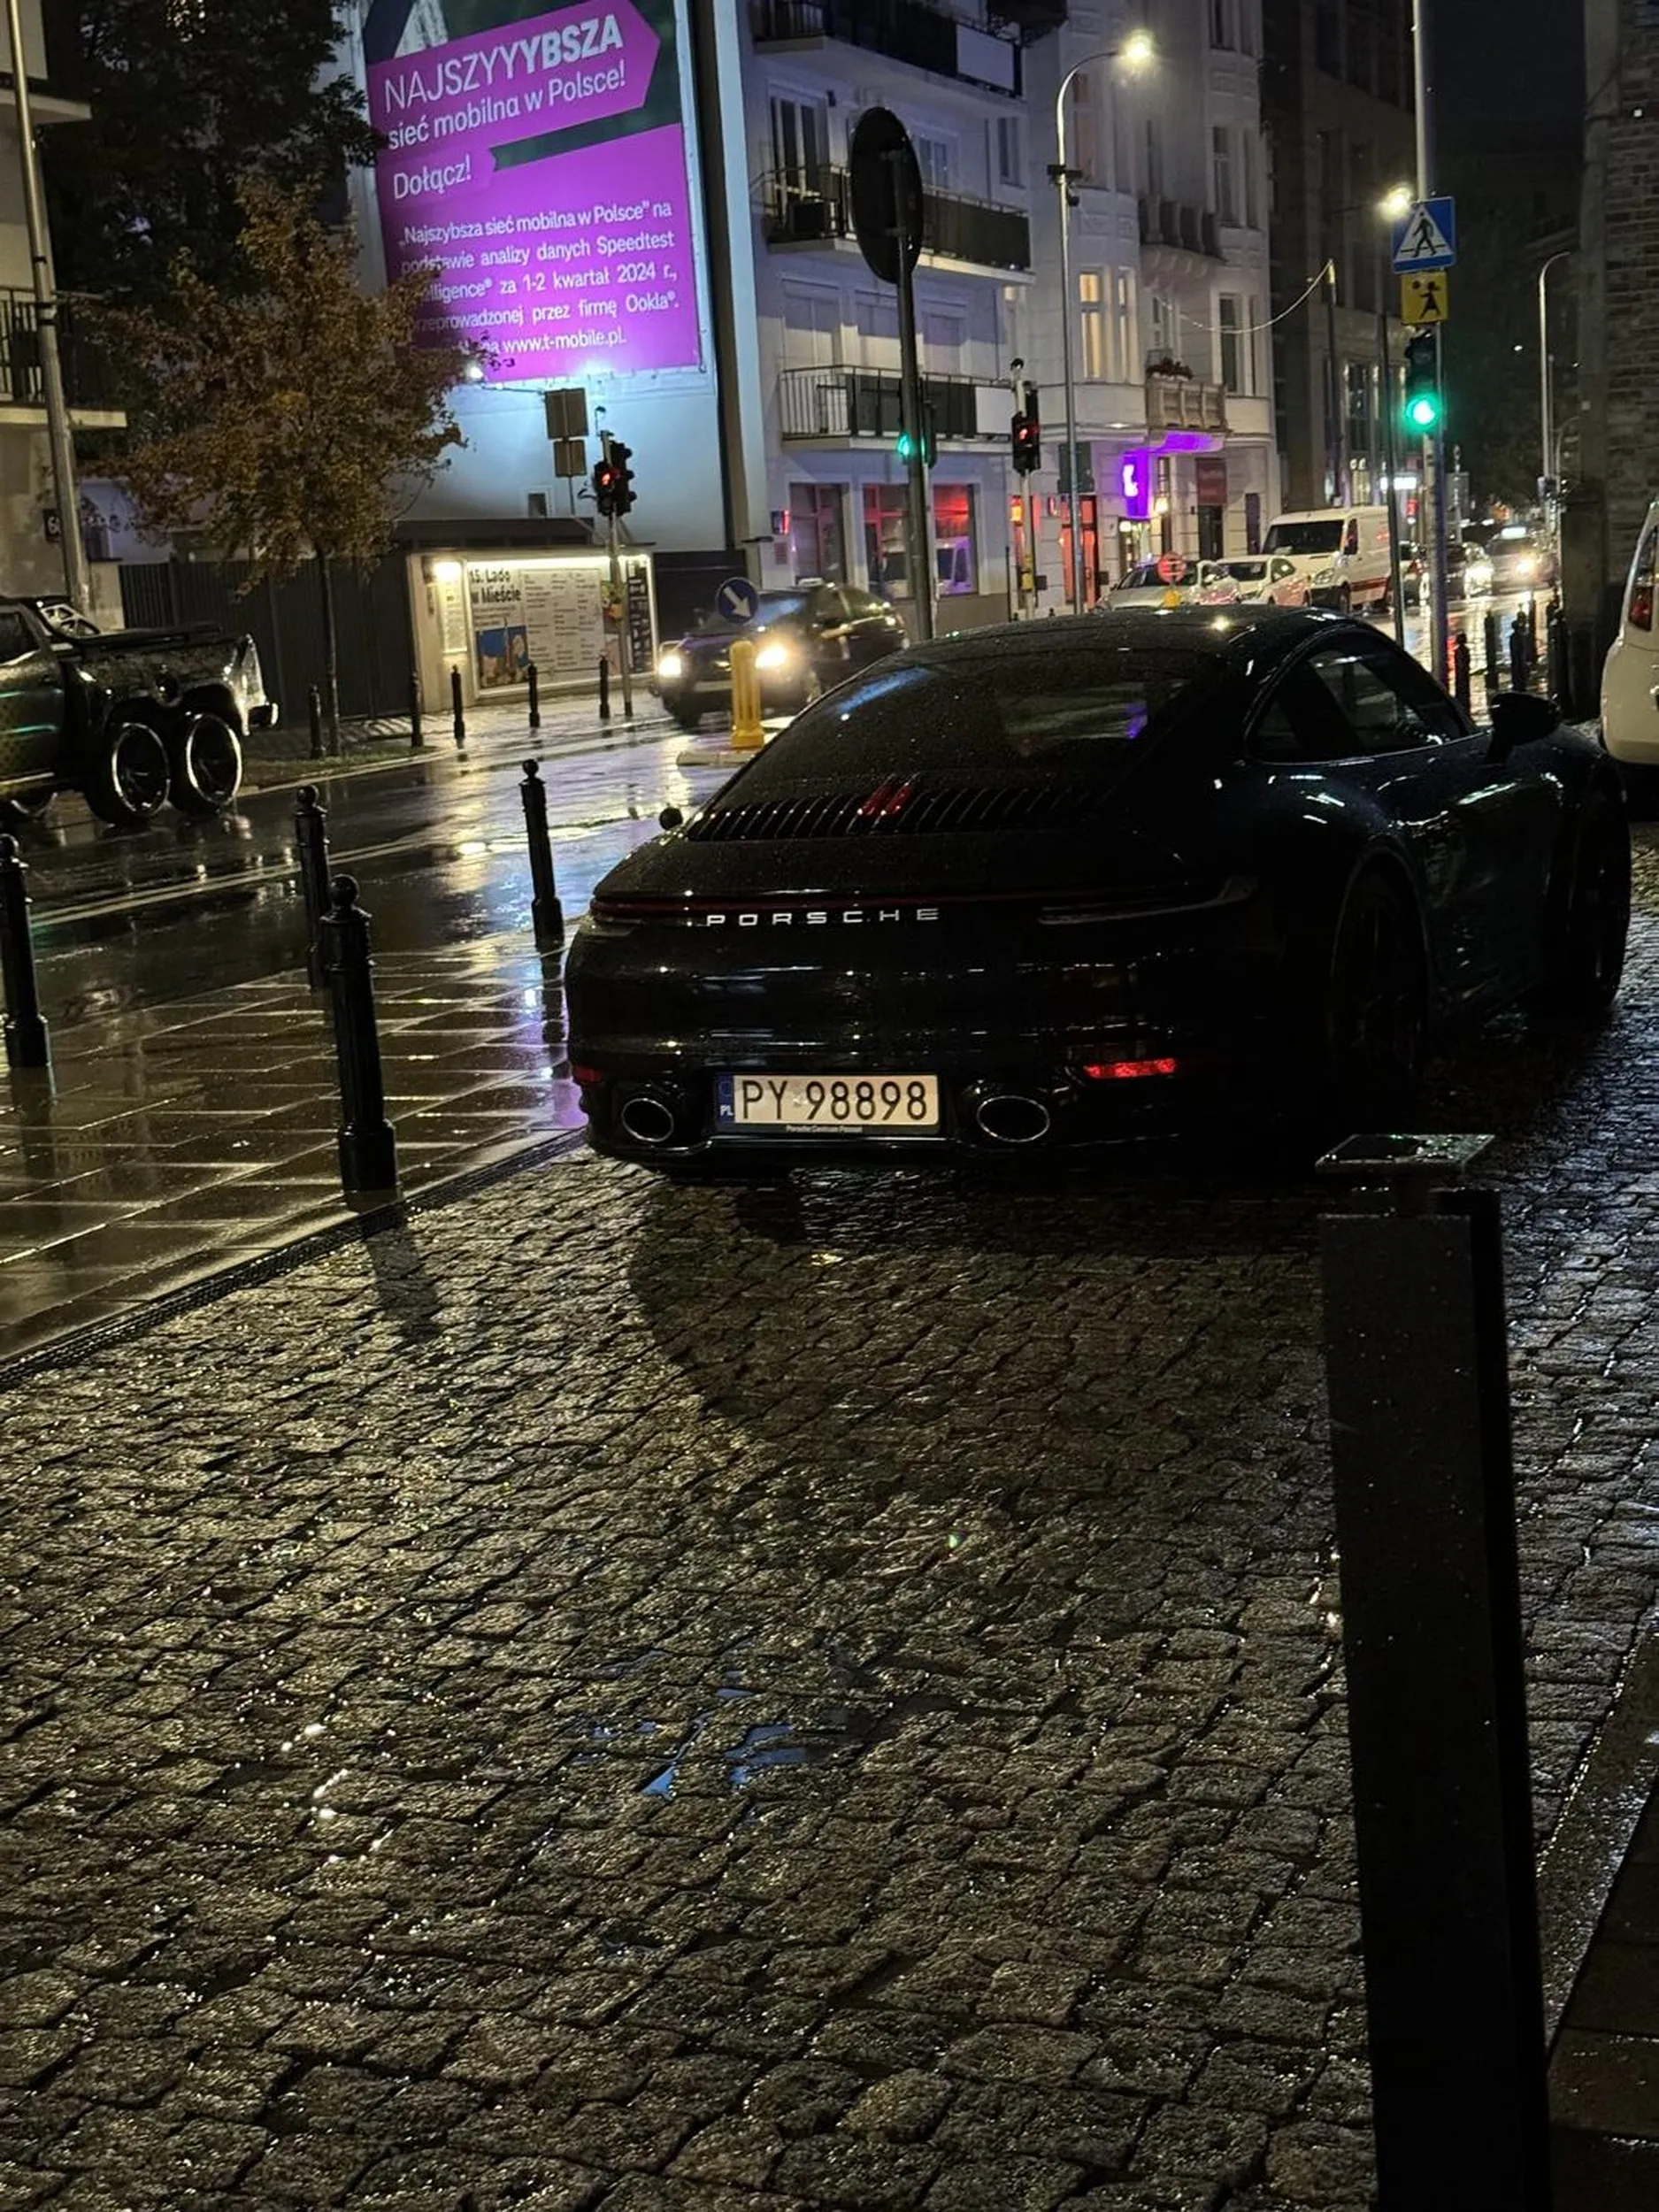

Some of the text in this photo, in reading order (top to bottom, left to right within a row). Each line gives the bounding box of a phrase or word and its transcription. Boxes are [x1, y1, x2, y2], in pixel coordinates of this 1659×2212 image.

[384, 13, 624, 113] NAJSZYYYBSZA
[388, 59, 626, 150] sieć mobilna w Polsce!
[393, 154, 472, 201] Dołącz!
[485, 215, 515, 234] sieć
[516, 211, 575, 232] mobilna
[577, 211, 592, 226] w
[653, 202, 672, 218] na
[480, 244, 530, 265] analizy
[536, 238, 591, 263] danych
[596, 230, 675, 257] Speedtest
[500, 280, 517, 295] za
[523, 272, 546, 292] 1-2
[552, 266, 611, 290] kwartał
[617, 261, 657, 284] 2024
[533, 303, 571, 326] przez
[578, 299, 618, 319] firmę
[706, 908, 939, 927] PORSCHE
[719, 1105, 734, 1117] PL
[742, 1080, 927, 1121] PY 98898
